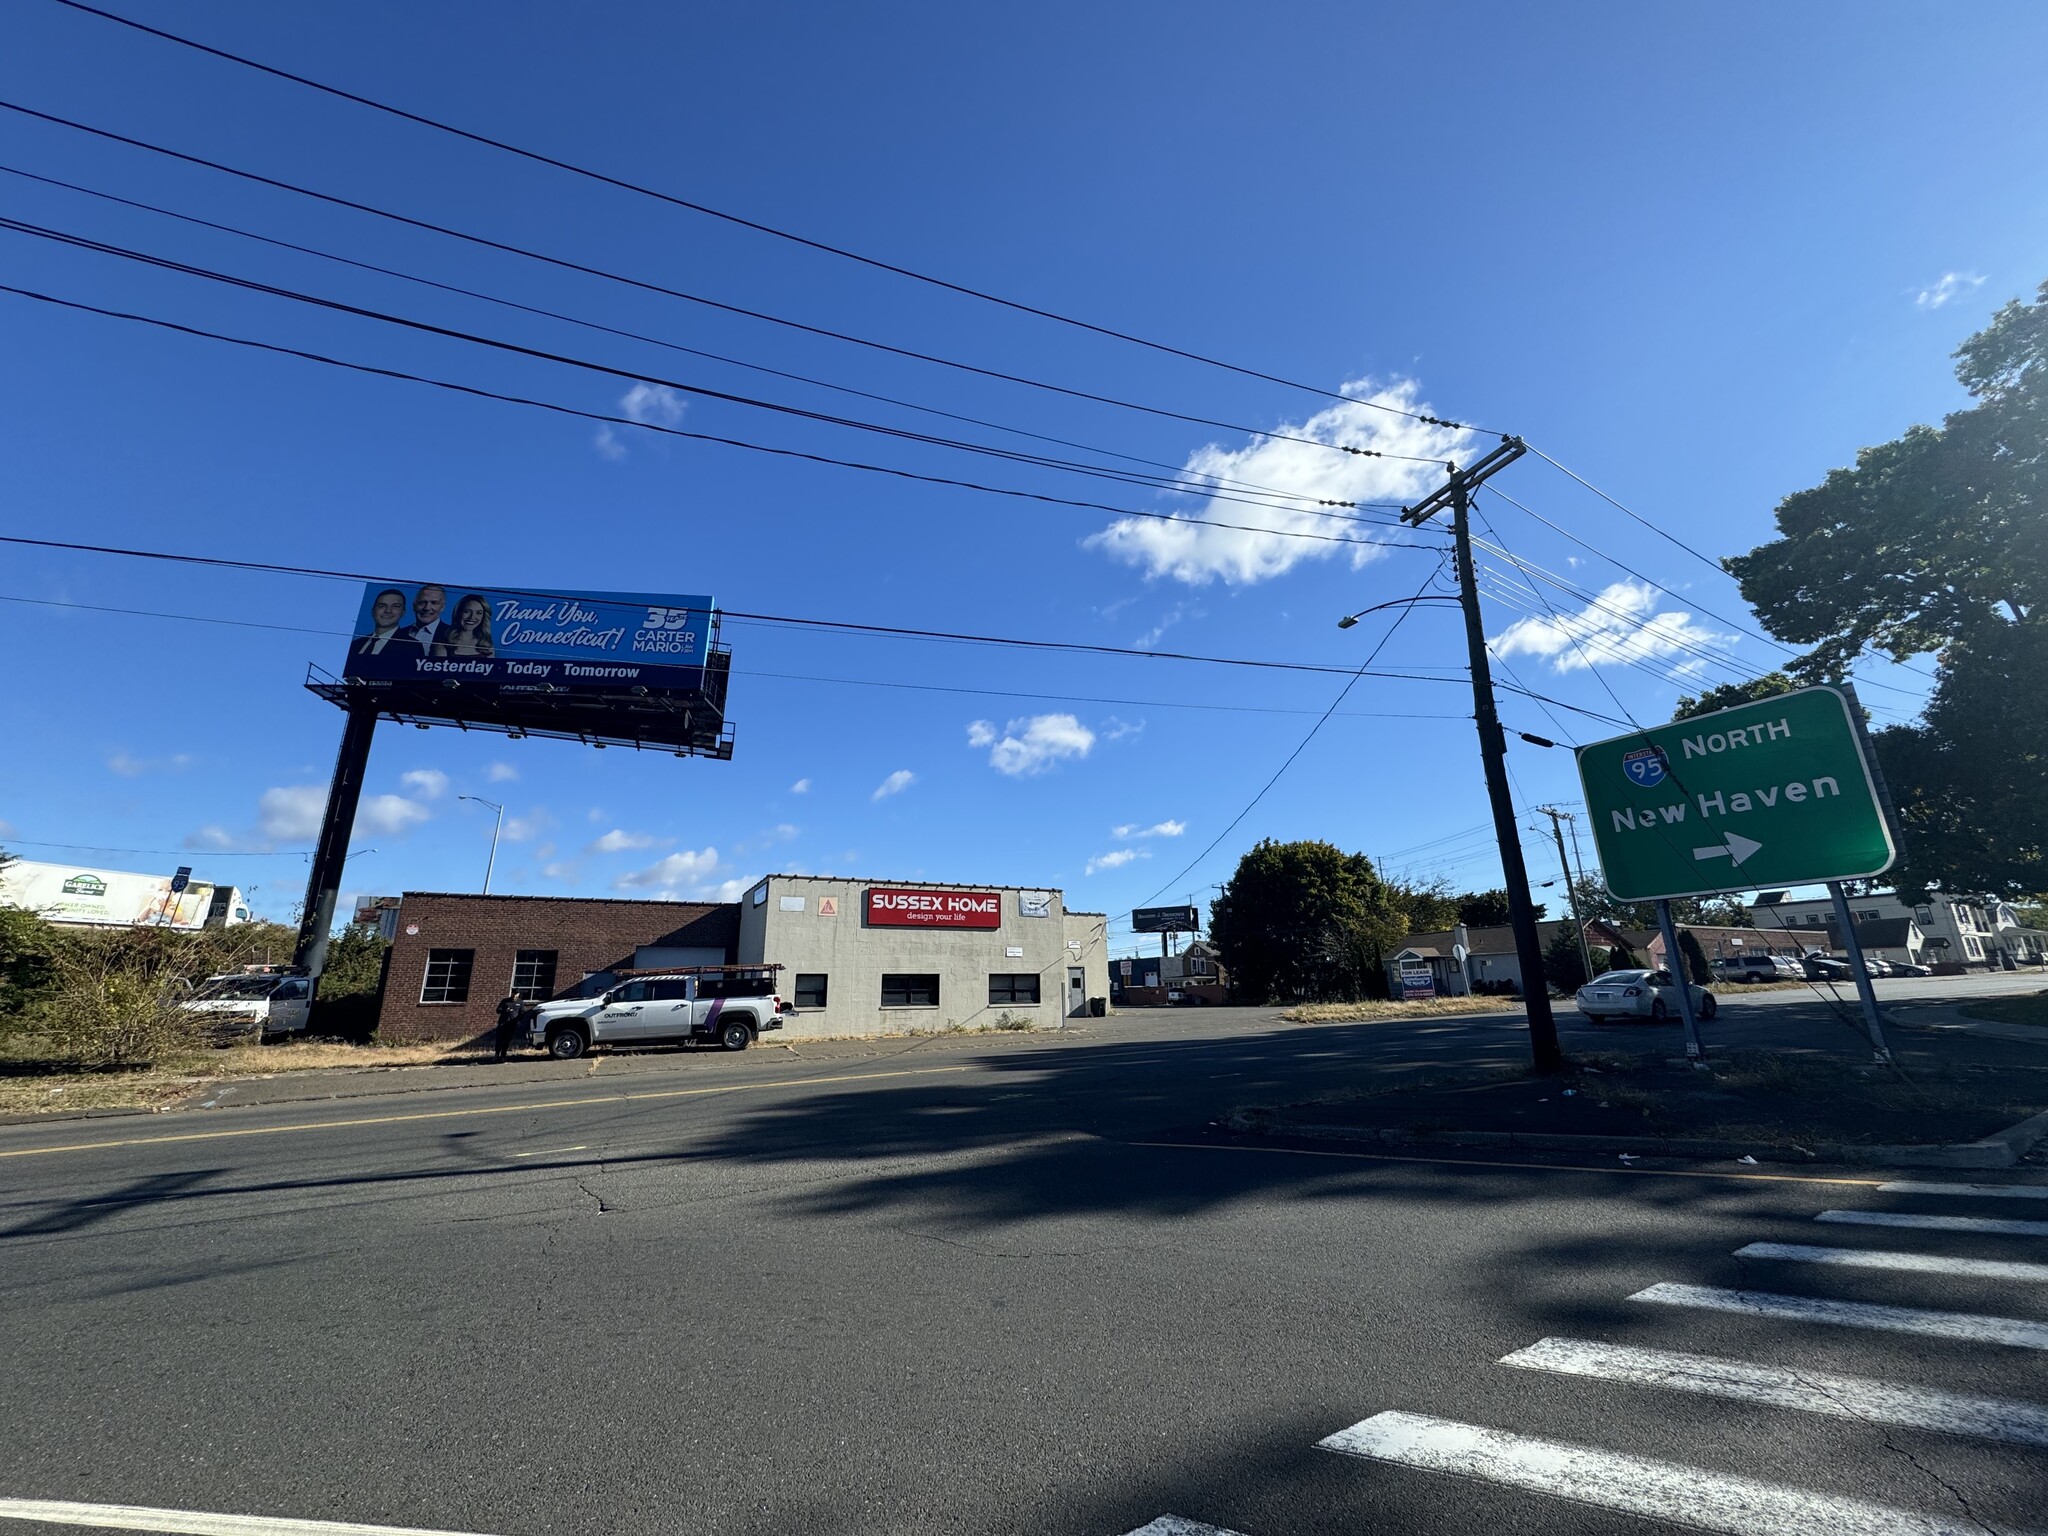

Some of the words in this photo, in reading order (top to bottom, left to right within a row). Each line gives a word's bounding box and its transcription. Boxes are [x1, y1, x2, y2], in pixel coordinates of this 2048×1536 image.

[495, 600, 556, 621] Thank
[555, 601, 599, 627] You,
[642, 606, 688, 630] 35
[500, 621, 626, 650] Connecticut!
[634, 630, 695, 643] CARTER
[632, 640, 682, 653] MARIO
[415, 659, 494, 676] Yesterday
[506, 661, 551, 677] Today
[564, 663, 640, 678] Tomorrow
[1681, 718, 1791, 760] NORTH
[1631, 758, 1662, 779] 95
[1611, 801, 1686, 834] New
[1698, 775, 1841, 818] Haven
[173, 880, 186, 890] 95
[872, 894, 943, 910] SUSSEX
[948, 897, 998, 913] HOME
[906, 912, 933, 922] design
[935, 914, 952, 922] your
[953, 913, 966, 921] life
